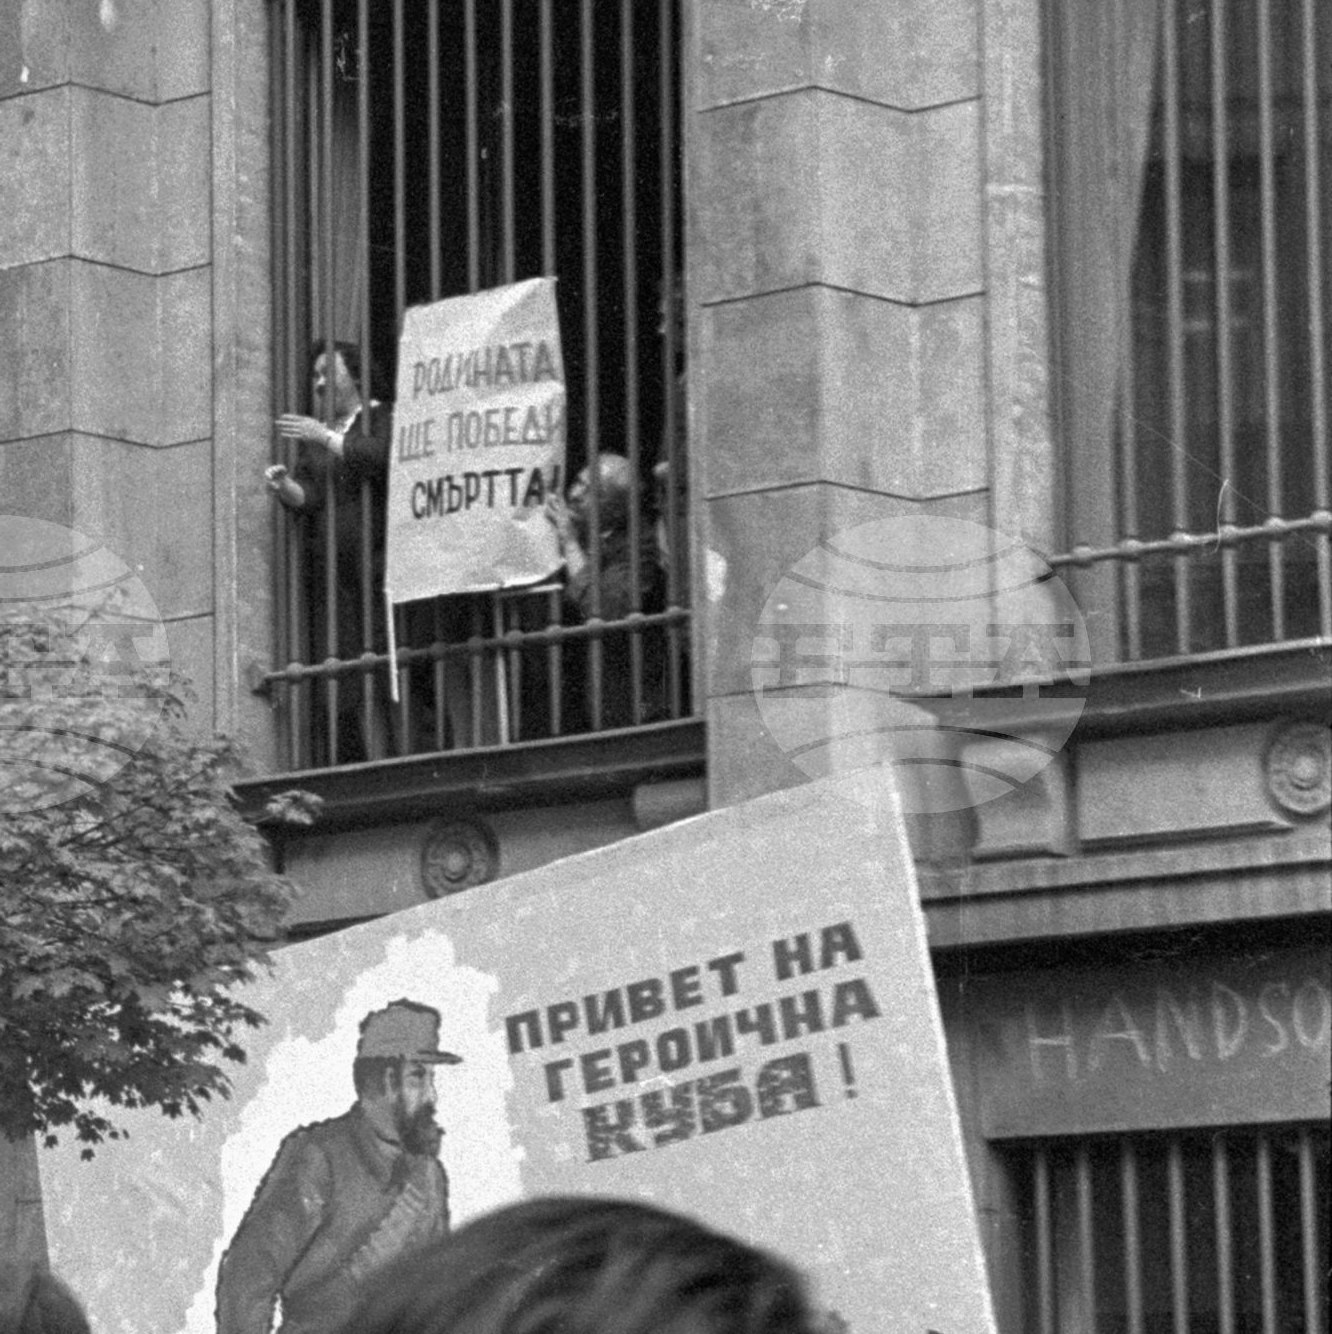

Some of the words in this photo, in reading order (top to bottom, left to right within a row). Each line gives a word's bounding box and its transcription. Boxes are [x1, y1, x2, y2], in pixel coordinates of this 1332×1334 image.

[413, 340, 558, 400] РОДИНАТА
[506, 951, 745, 1054] ПРИВЕТ
[772, 921, 864, 982] НА
[544, 978, 883, 1103] ГЕРОИЧНА
